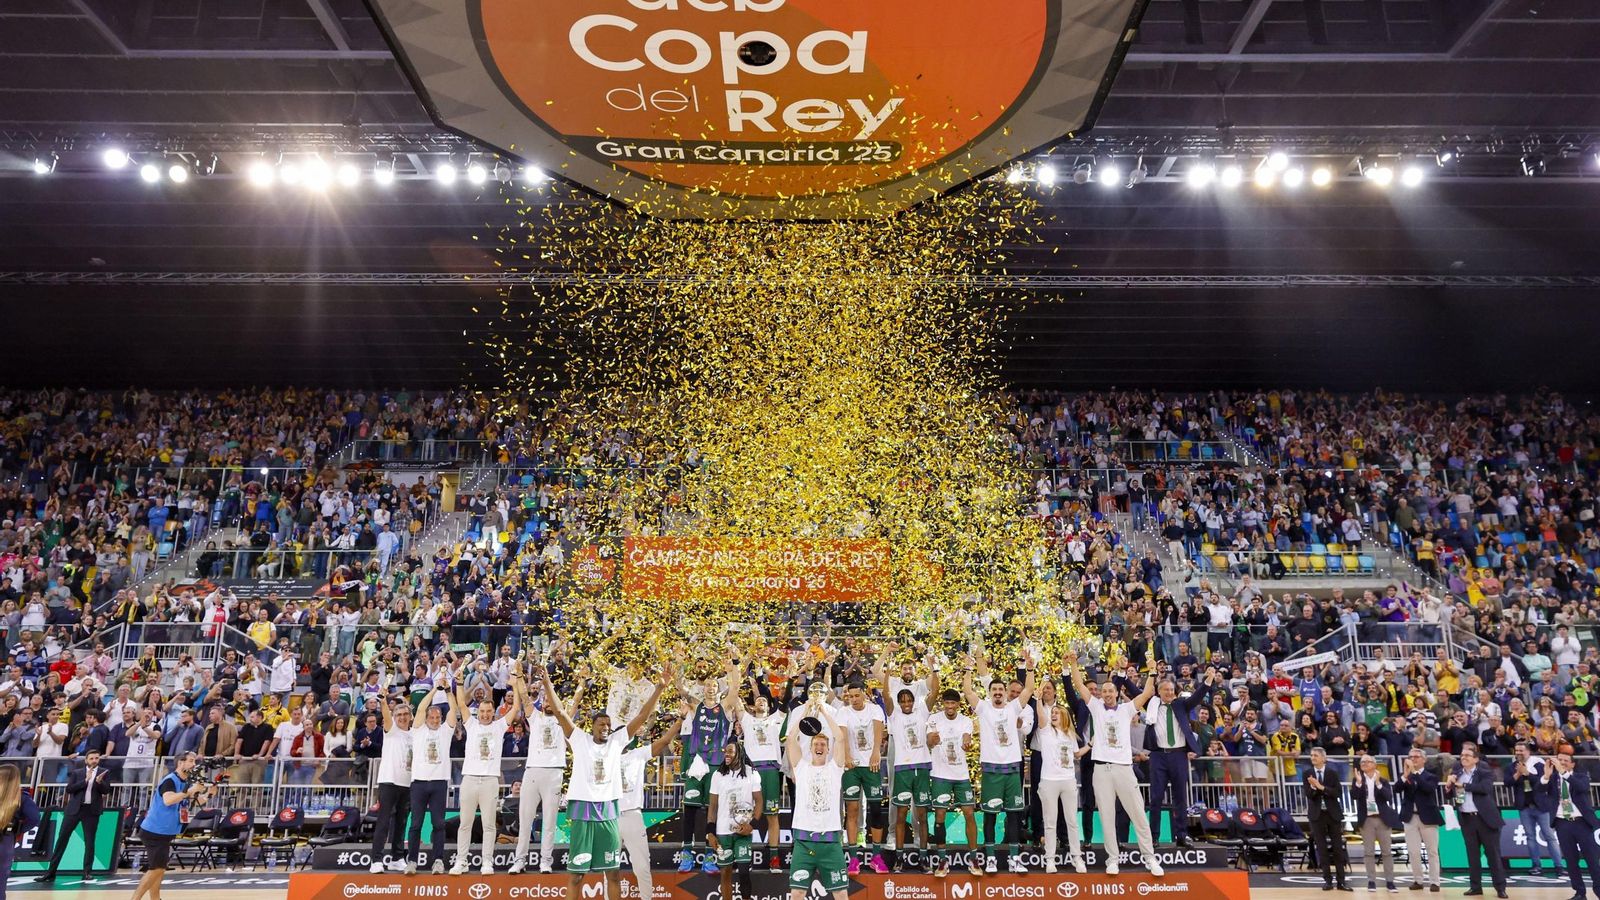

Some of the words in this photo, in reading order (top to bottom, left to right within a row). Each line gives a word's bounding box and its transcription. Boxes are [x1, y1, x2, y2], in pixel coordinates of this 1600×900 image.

[568, 14, 867, 84] Copa
[606, 83, 699, 112] del
[725, 89, 905, 140] Rey
[596, 141, 685, 160] Gran
[694, 145, 840, 163] Canaria
[850, 550, 886, 569] REY
[137, 744, 145, 755] 9
[344, 883, 402, 897] mediolanum
[415, 886, 448, 897] IONOS
[985, 883, 1045, 898] endesa
[1092, 884, 1125, 895] IONOS
[1137, 882, 1188, 896] mediolanum
